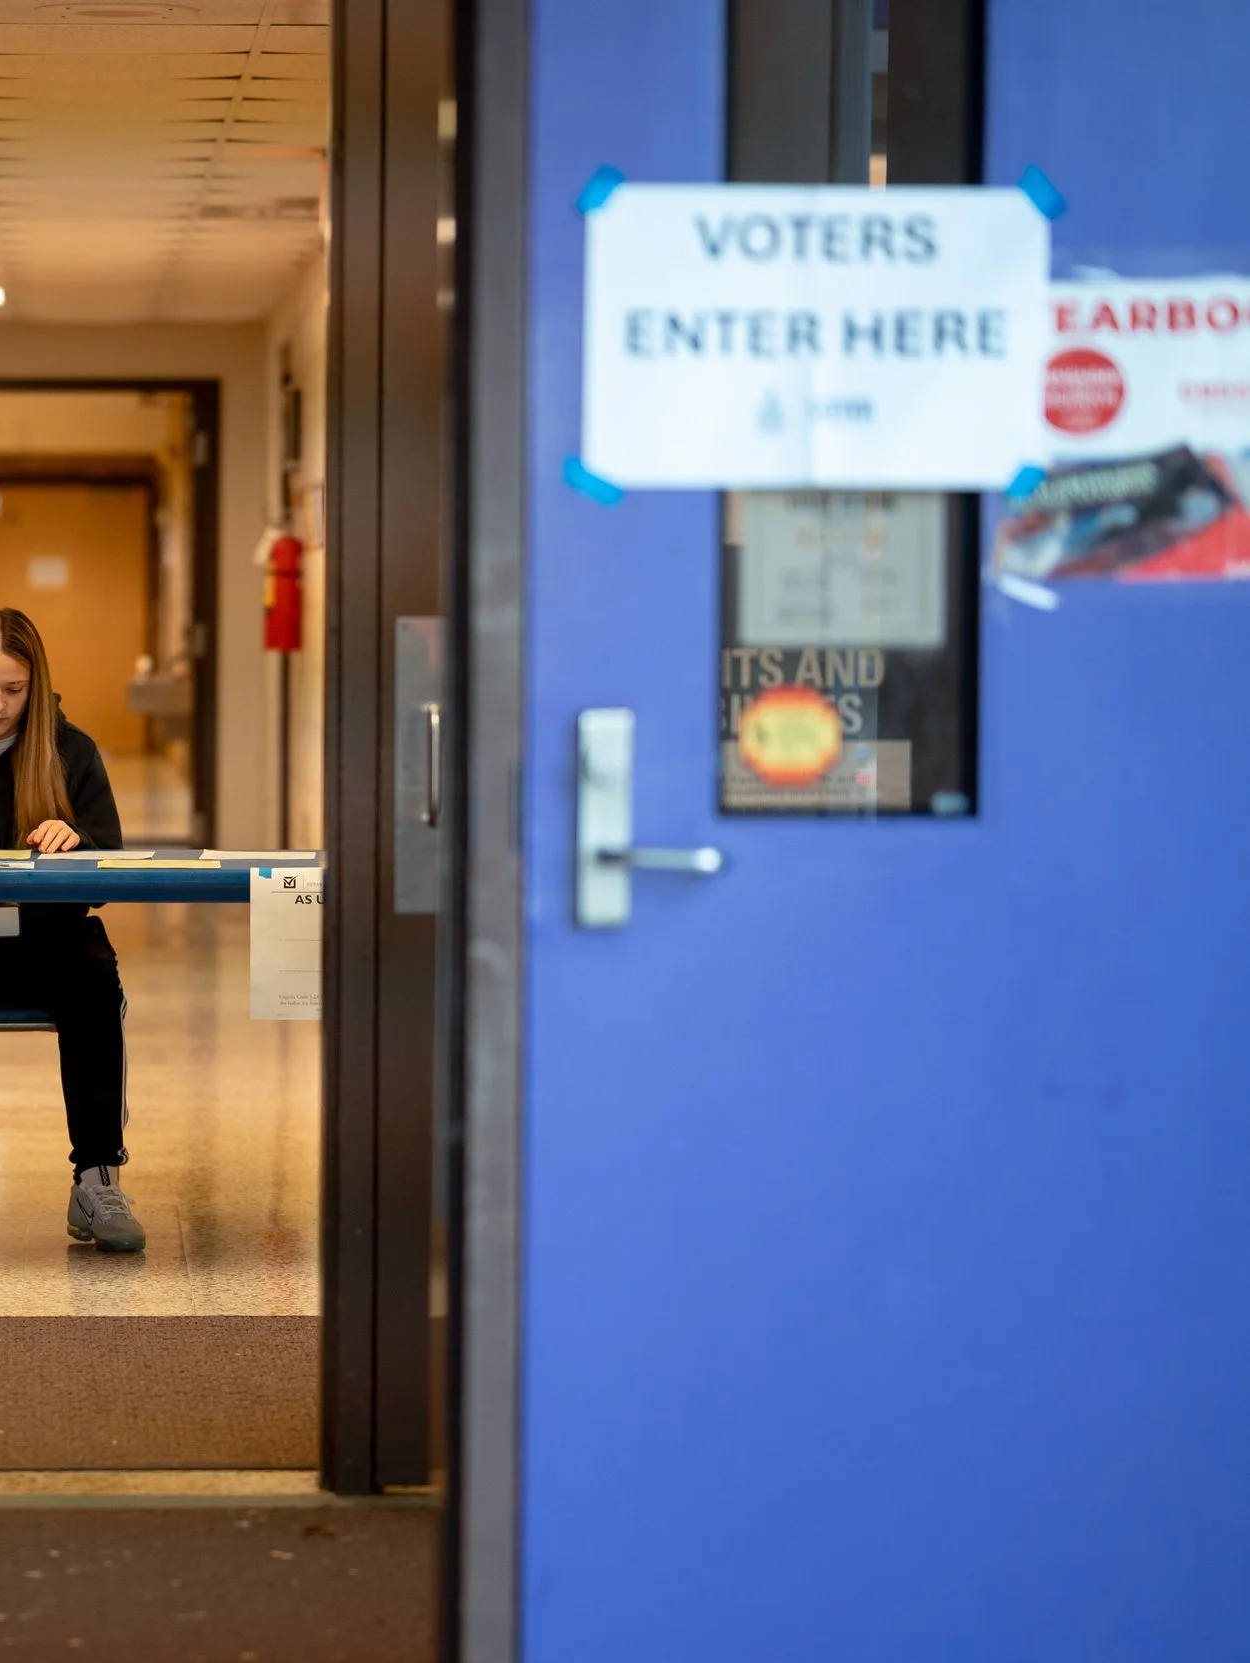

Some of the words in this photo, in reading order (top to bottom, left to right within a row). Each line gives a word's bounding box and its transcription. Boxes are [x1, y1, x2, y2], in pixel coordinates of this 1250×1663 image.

[693, 212, 938, 263] VOTERS
[623, 309, 824, 359] ENTER
[840, 309, 1009, 360] HERE
[1054, 298, 1250, 335] EARBO
[793, 646, 886, 689] AND
[294, 894, 312, 905] AS
